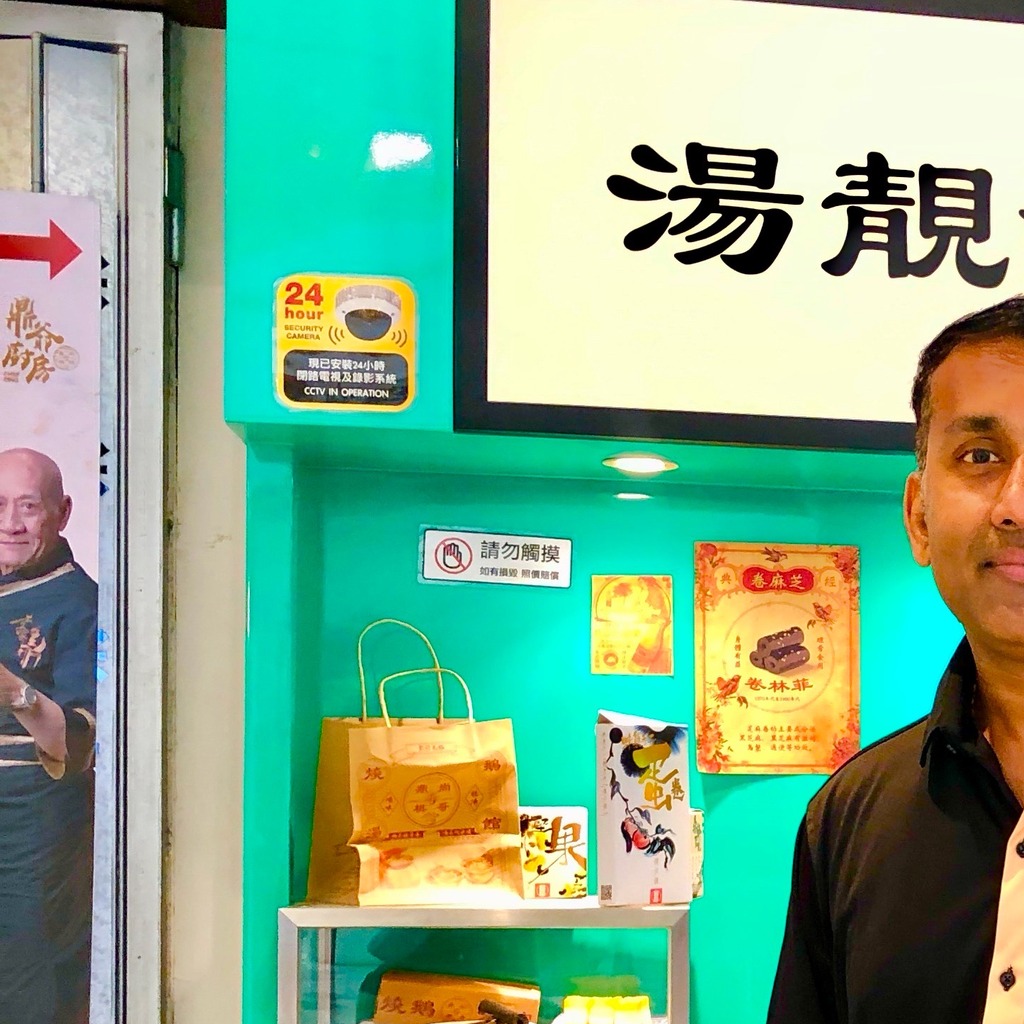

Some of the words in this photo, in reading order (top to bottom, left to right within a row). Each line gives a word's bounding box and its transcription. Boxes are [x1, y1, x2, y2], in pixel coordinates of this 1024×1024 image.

[285, 282, 323, 306] 24
[285, 307, 324, 320] hour
[284, 324, 323, 332] SECURITY
[308, 358, 385, 372] 現已安裝24小時
[304, 387, 326, 395] CCTV
[329, 388, 338, 396] IN
[341, 388, 389, 398] OPERATION
[480, 540, 561, 563] 請勿觸摸
[480, 567, 518, 578] 如有損毀
